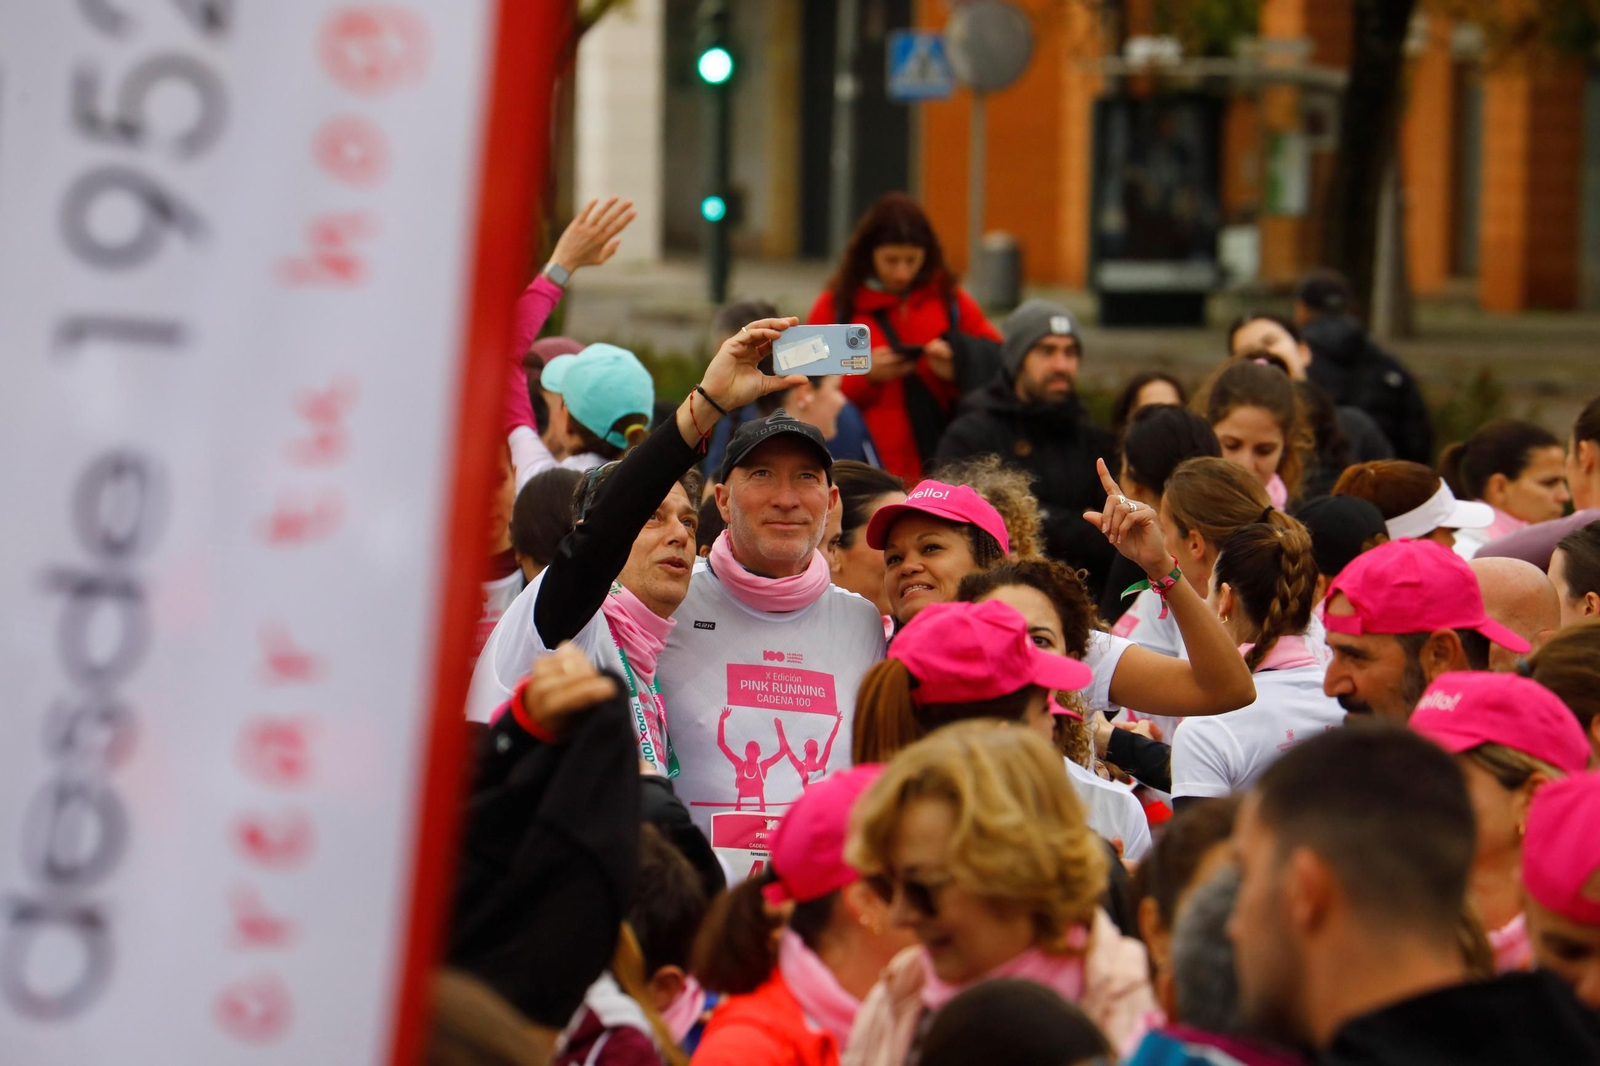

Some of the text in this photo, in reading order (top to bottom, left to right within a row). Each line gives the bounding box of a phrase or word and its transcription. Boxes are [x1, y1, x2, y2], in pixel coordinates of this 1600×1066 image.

[763, 650, 785, 662] 100
[765, 671, 802, 683] X Edición
[740, 679, 826, 698] PINK RUNNING
[757, 693, 811, 707] CADENA 100
[2, 445, 172, 1024] desde
